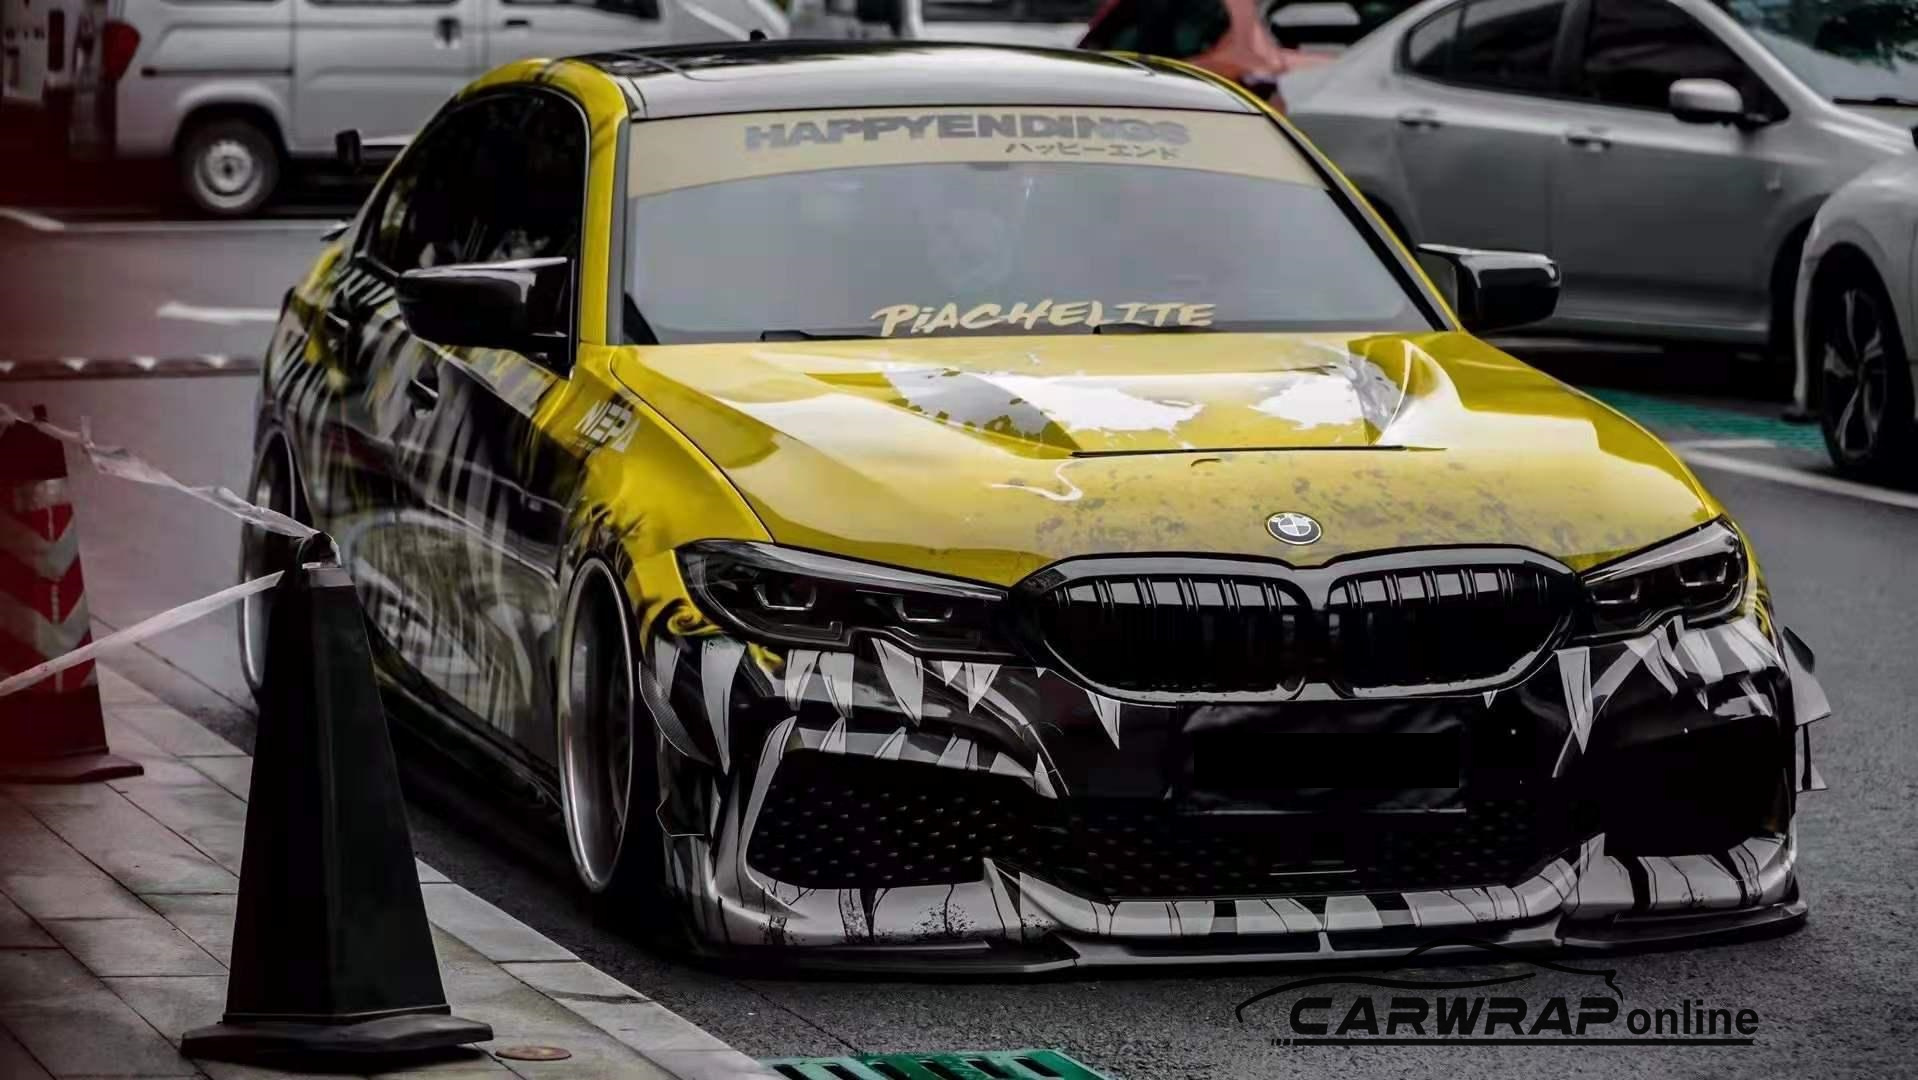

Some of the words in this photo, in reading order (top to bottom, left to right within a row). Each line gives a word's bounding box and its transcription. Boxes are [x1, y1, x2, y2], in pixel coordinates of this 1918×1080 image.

[745, 113, 1191, 152] HAPPYENDINGS
[1005, 142, 1180, 161] ハッピーエンド
